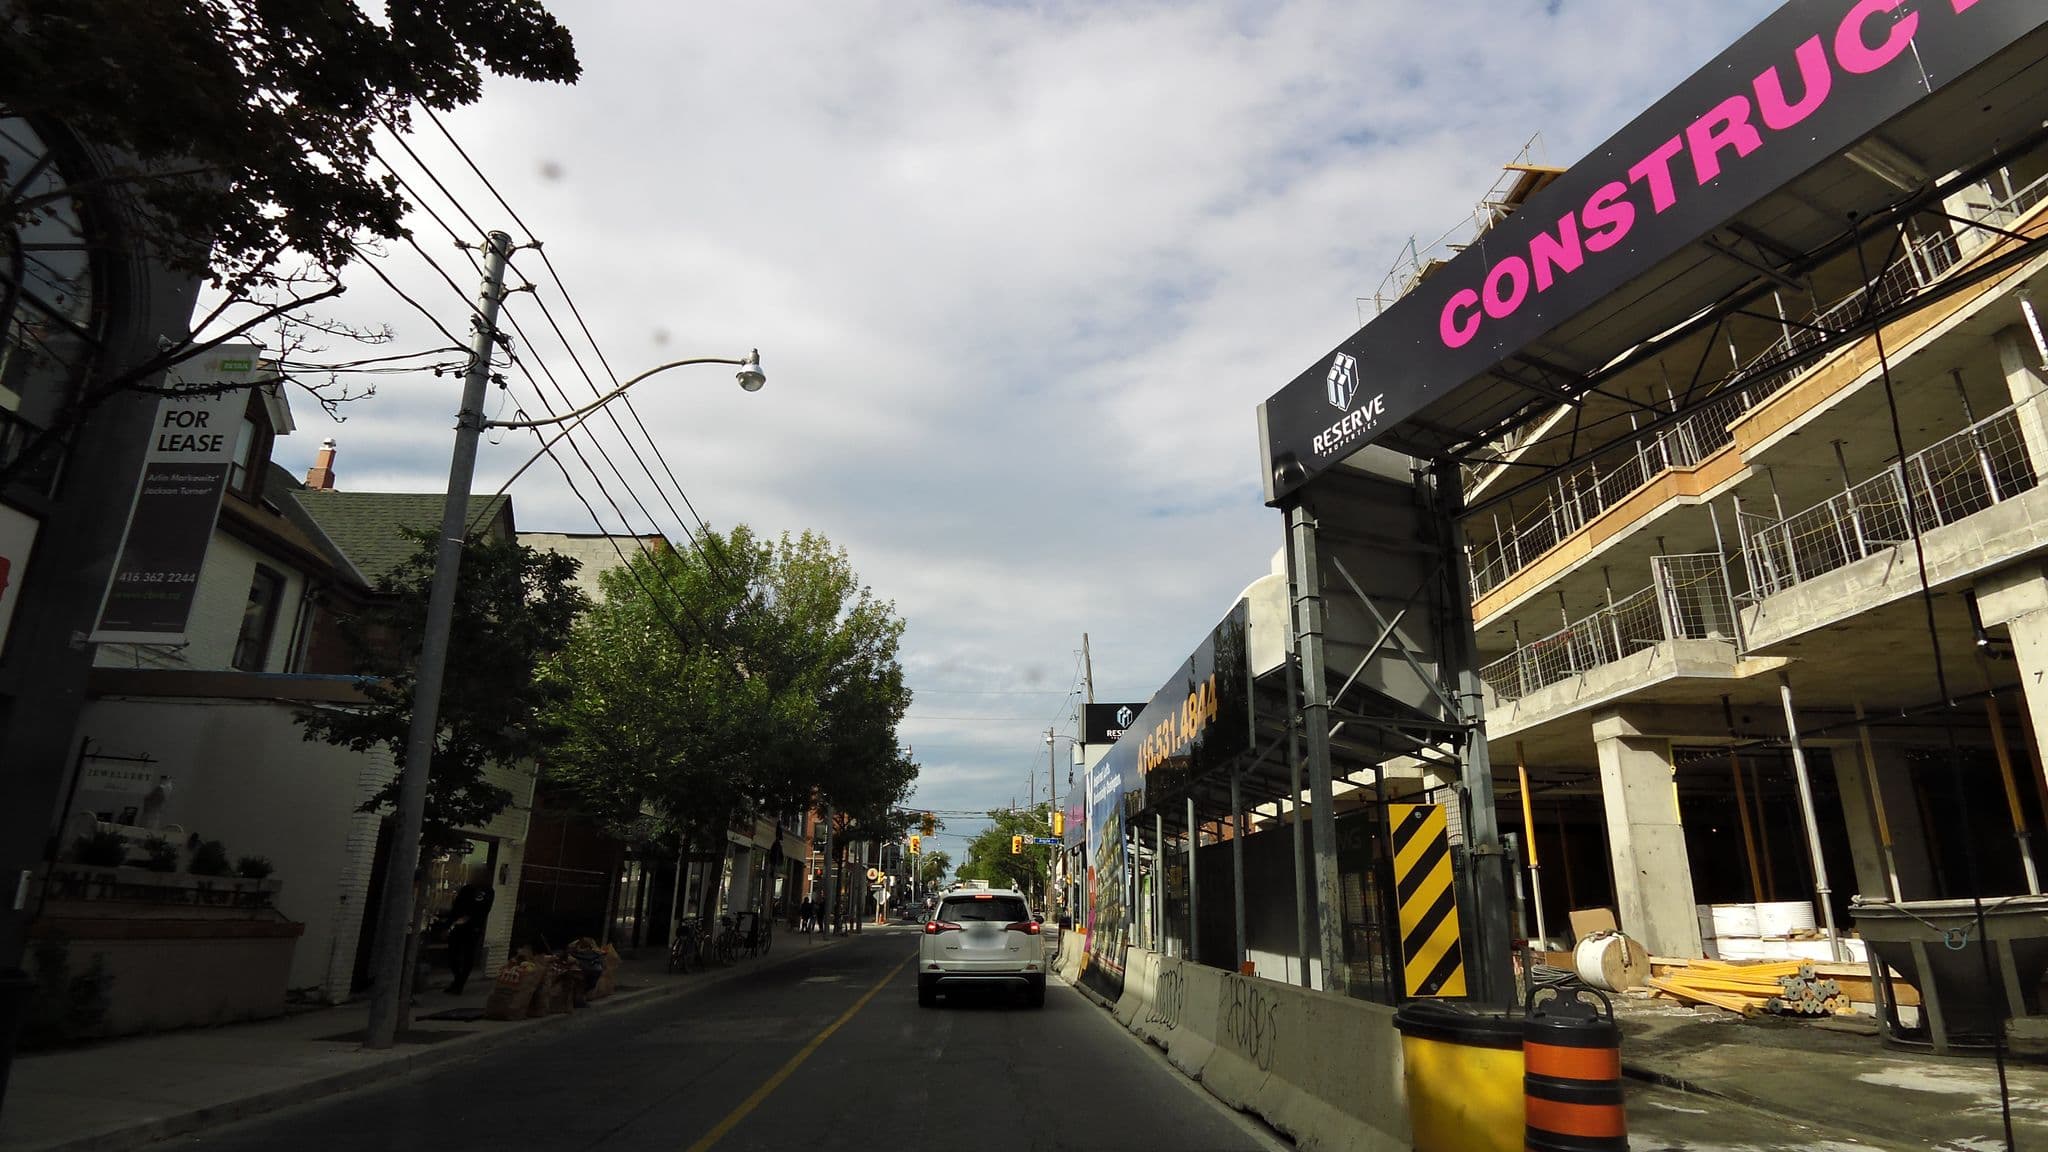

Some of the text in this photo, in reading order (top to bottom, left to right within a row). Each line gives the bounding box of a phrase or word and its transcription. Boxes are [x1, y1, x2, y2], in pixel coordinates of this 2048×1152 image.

[1439, 0, 1980, 348] CONSTRUC
[163, 410, 210, 428] FOR
[1312, 393, 1386, 454] RESERVE
[1322, 419, 1378, 458] PROPERTIES
[158, 434, 224, 452] LEASE
[119, 572, 195, 583] 416 362 2244
[1137, 672, 1218, 778] 416.531.4844
